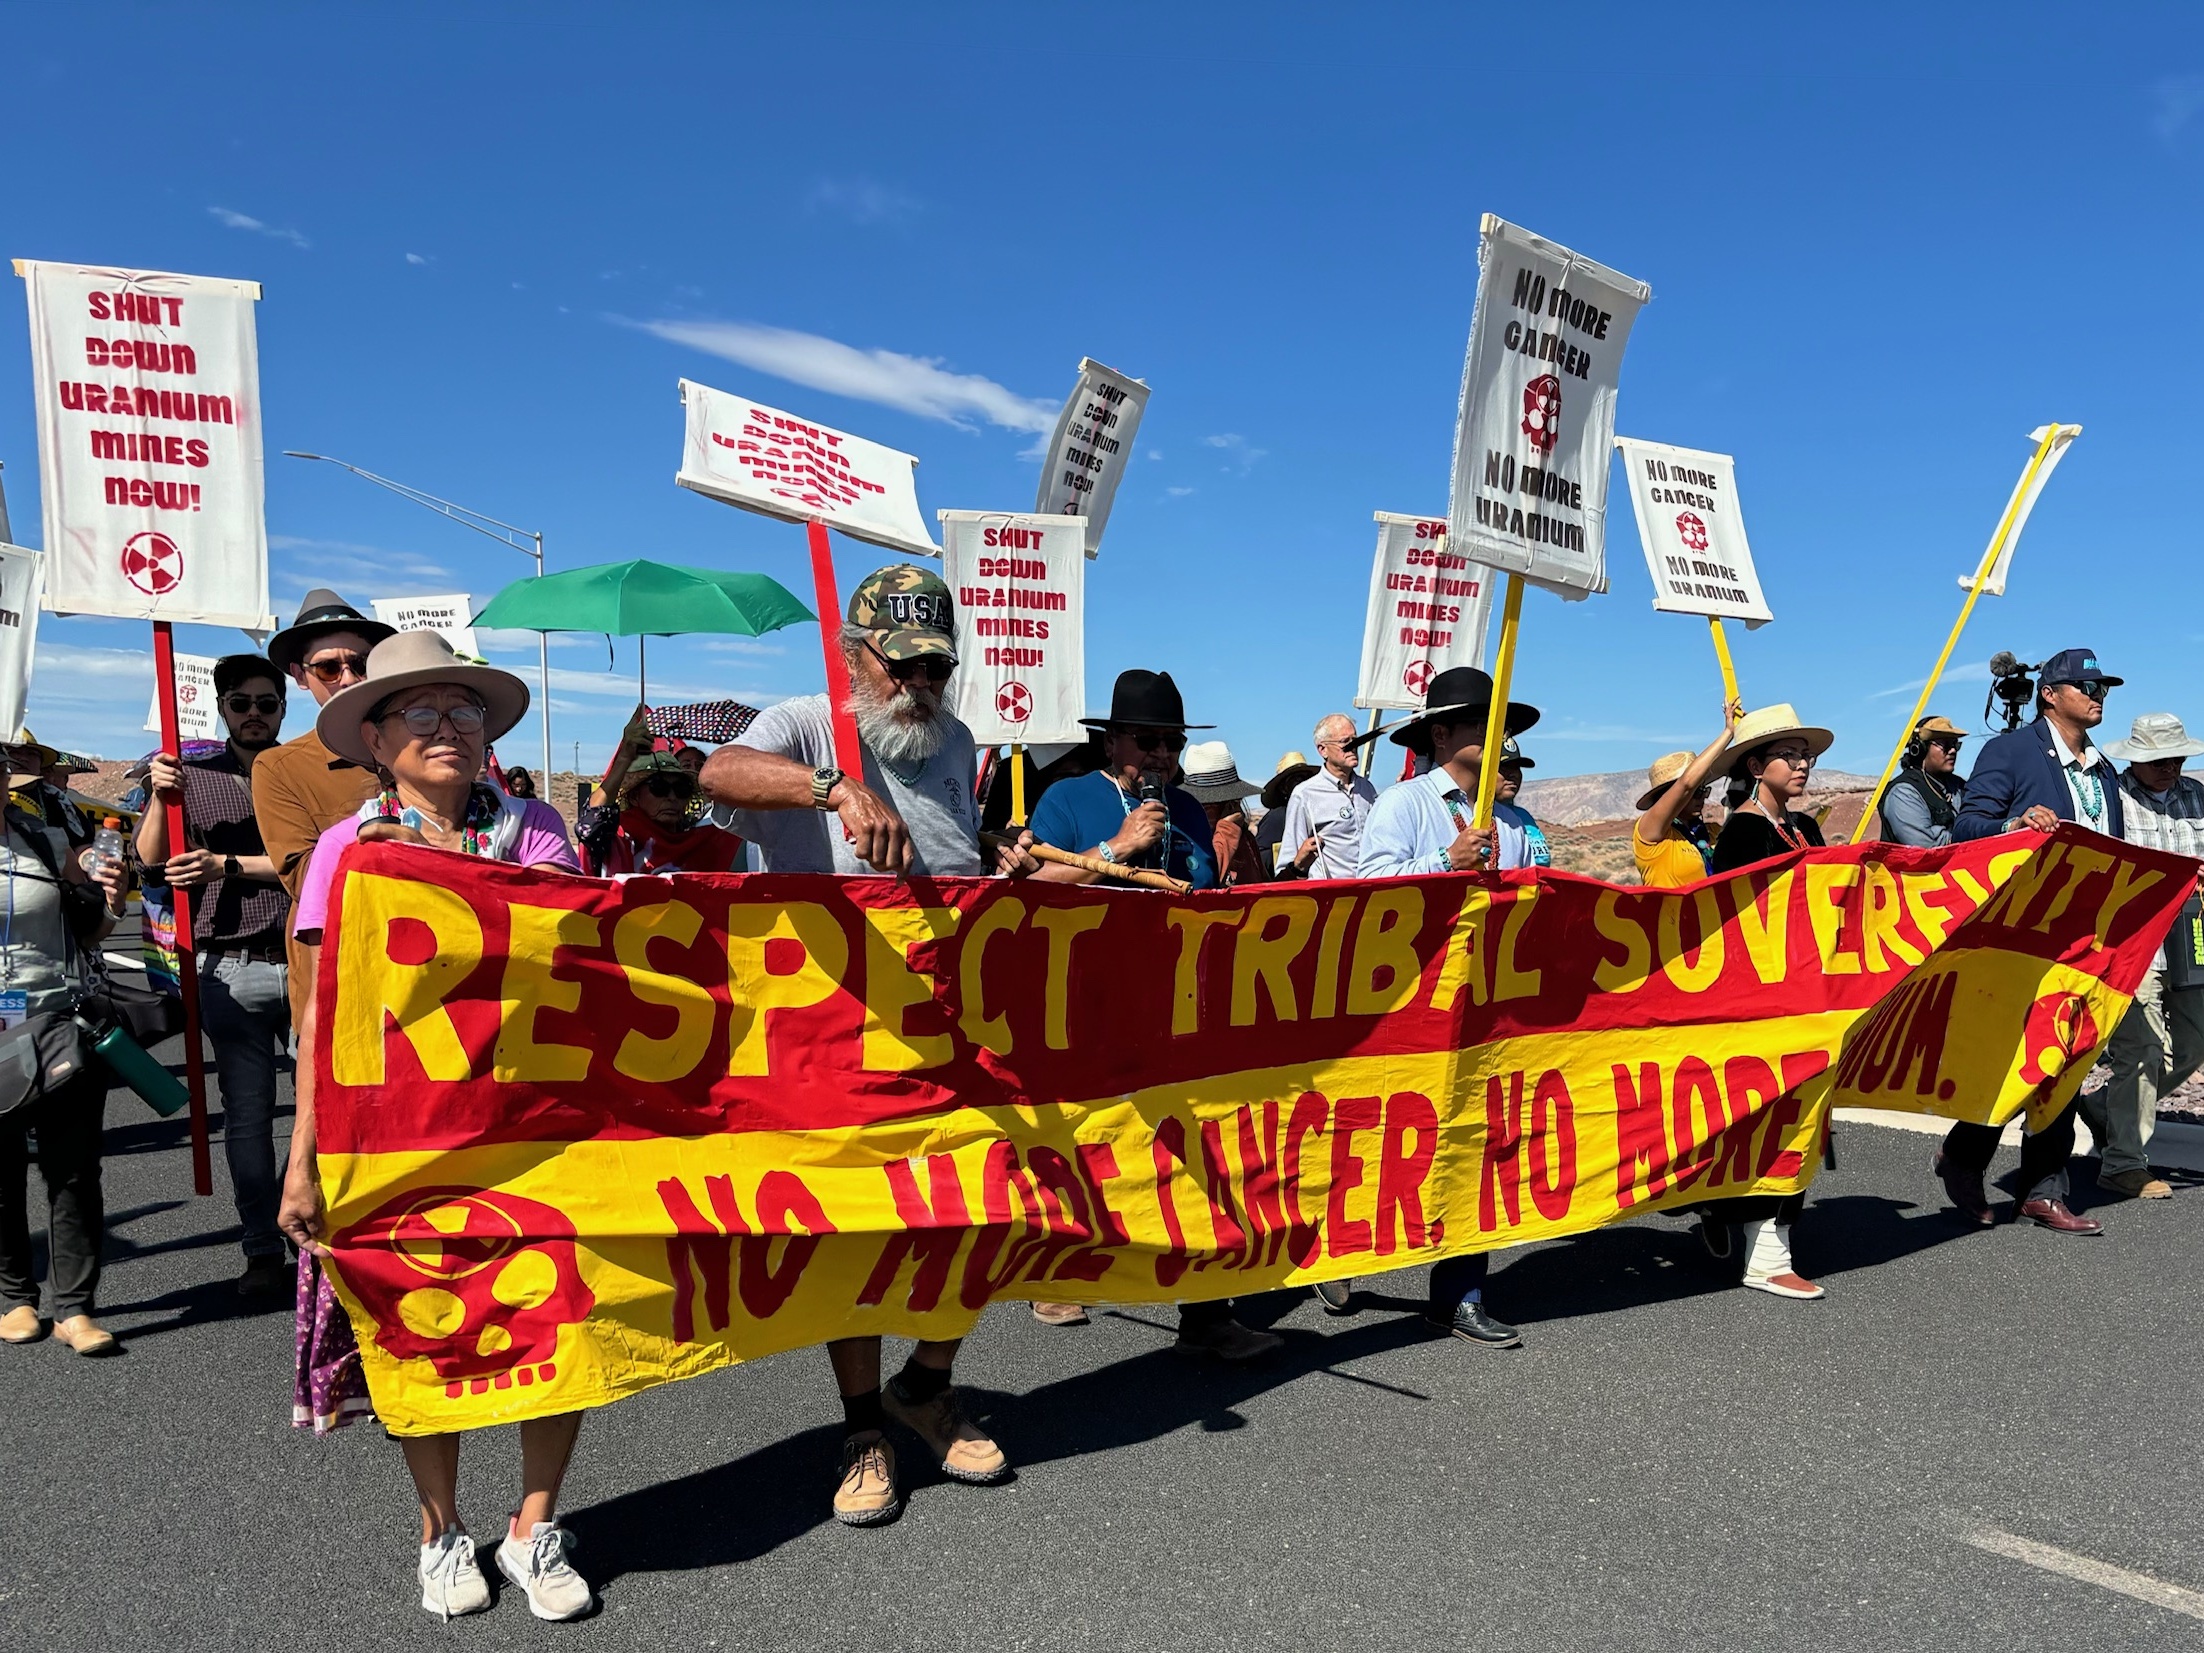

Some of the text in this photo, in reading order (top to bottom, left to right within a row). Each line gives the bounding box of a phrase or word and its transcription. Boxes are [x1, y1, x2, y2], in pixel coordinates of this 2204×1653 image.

[88, 290, 184, 327] SHUT
[1512, 268, 1612, 342] NO MORE
[86, 337, 196, 375] DOWN
[1504, 320, 1592, 381] CANCER
[59, 381, 233, 425] URANIUM
[750, 408, 843, 447] SHUT
[91, 430, 209, 468] MINES
[712, 432, 885, 494] URANIUM
[743, 424, 850, 468] DOWN
[739, 455, 861, 500] MINES
[1485, 449, 1582, 510] NO MORE
[1645, 459, 1717, 490] NO MORE
[105, 477, 201, 513] NOW!
[1650, 487, 1716, 513] CANCER
[983, 528, 1044, 550] SHUT
[1415, 523, 1447, 540] SH
[1476, 497, 1585, 553] URANIUM
[979, 558, 1046, 580] DOWN
[1666, 556, 1739, 582] NO MORE
[959, 587, 1066, 611] URANIUM
[1669, 580, 1750, 604] URANIUM
[397, 608, 456, 621] NO MORE
[888, 594, 949, 628] USA
[977, 618, 1049, 640] MINES
[1400, 627, 1452, 648] NOW!
[984, 648, 1044, 668] NOW!
[178, 675, 210, 685] ANCER
[332, 870, 1109, 1086] RESPECT
[1167, 884, 1544, 1036] TRIBAL
[658, 1171, 838, 1345] NO
[857, 1139, 1131, 1314] MORE
[1479, 1069, 1576, 1233] NO
[1613, 1051, 1830, 1209] MORE
